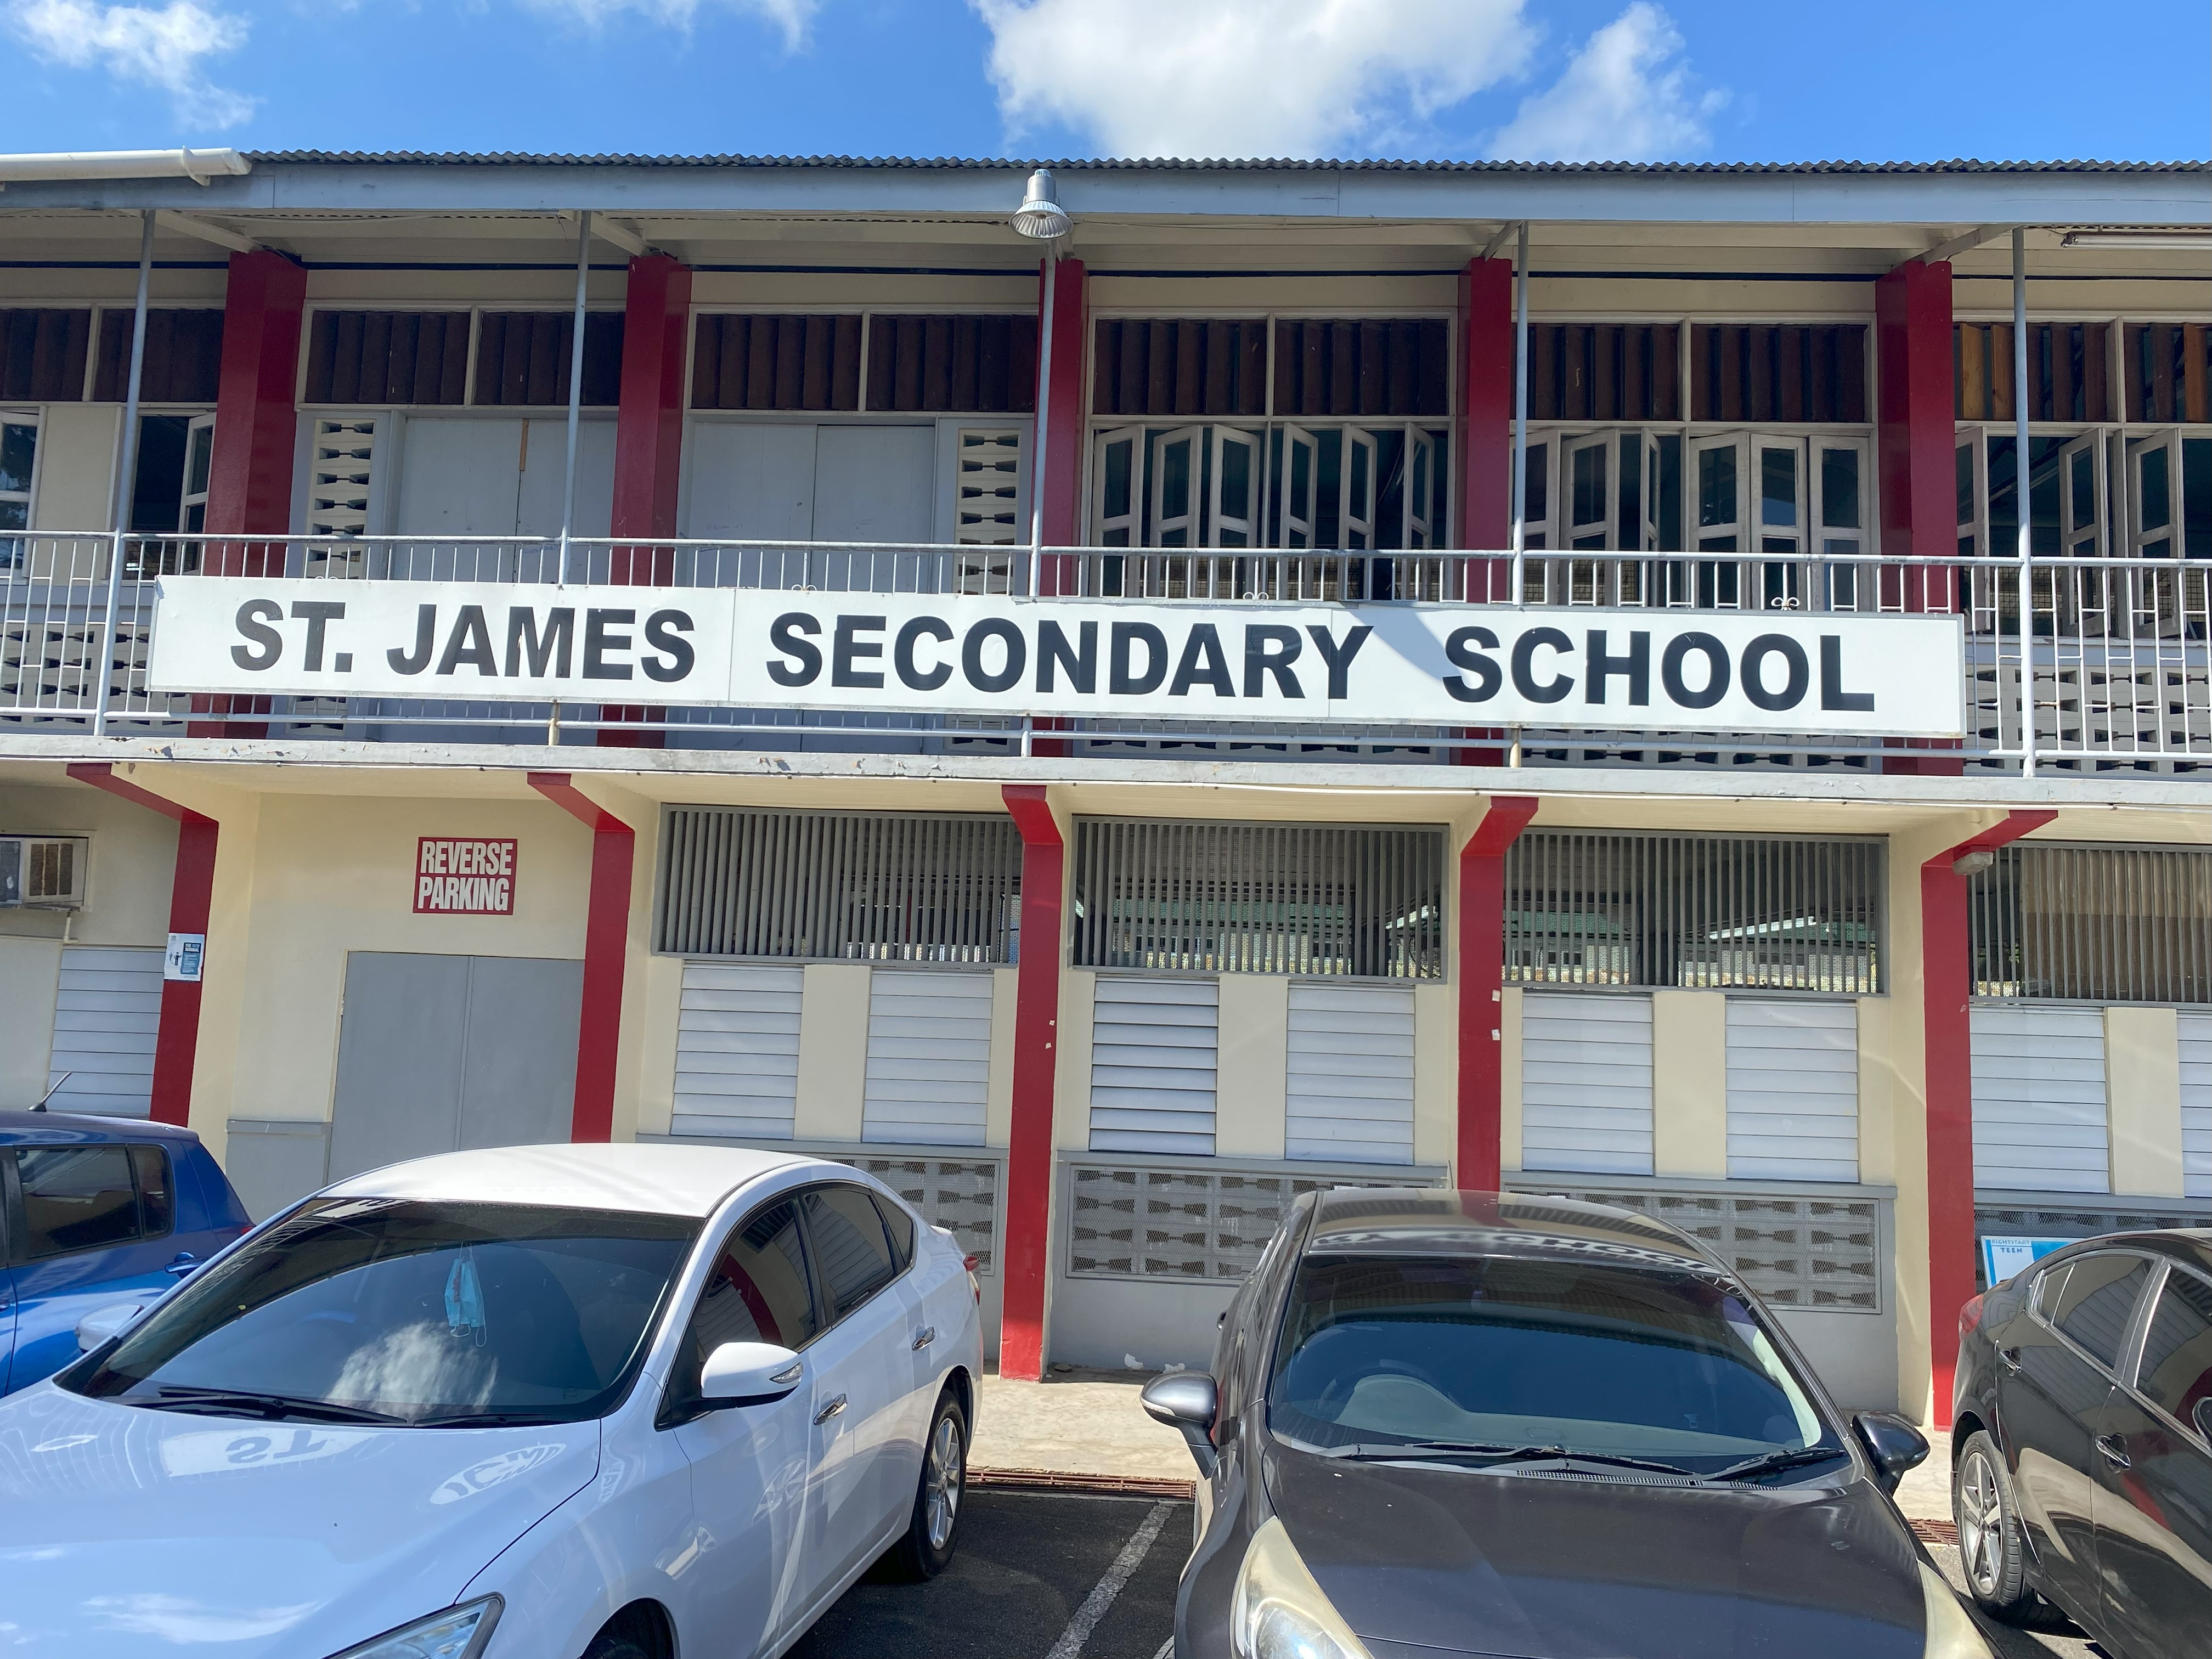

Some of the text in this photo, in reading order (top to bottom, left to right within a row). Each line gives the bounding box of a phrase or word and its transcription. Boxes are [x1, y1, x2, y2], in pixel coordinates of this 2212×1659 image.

[232, 599, 1875, 712] ST. JAMES SECONDARY SCHOOL
[420, 841, 514, 876] REVERSE
[417, 876, 509, 911] PARKING
